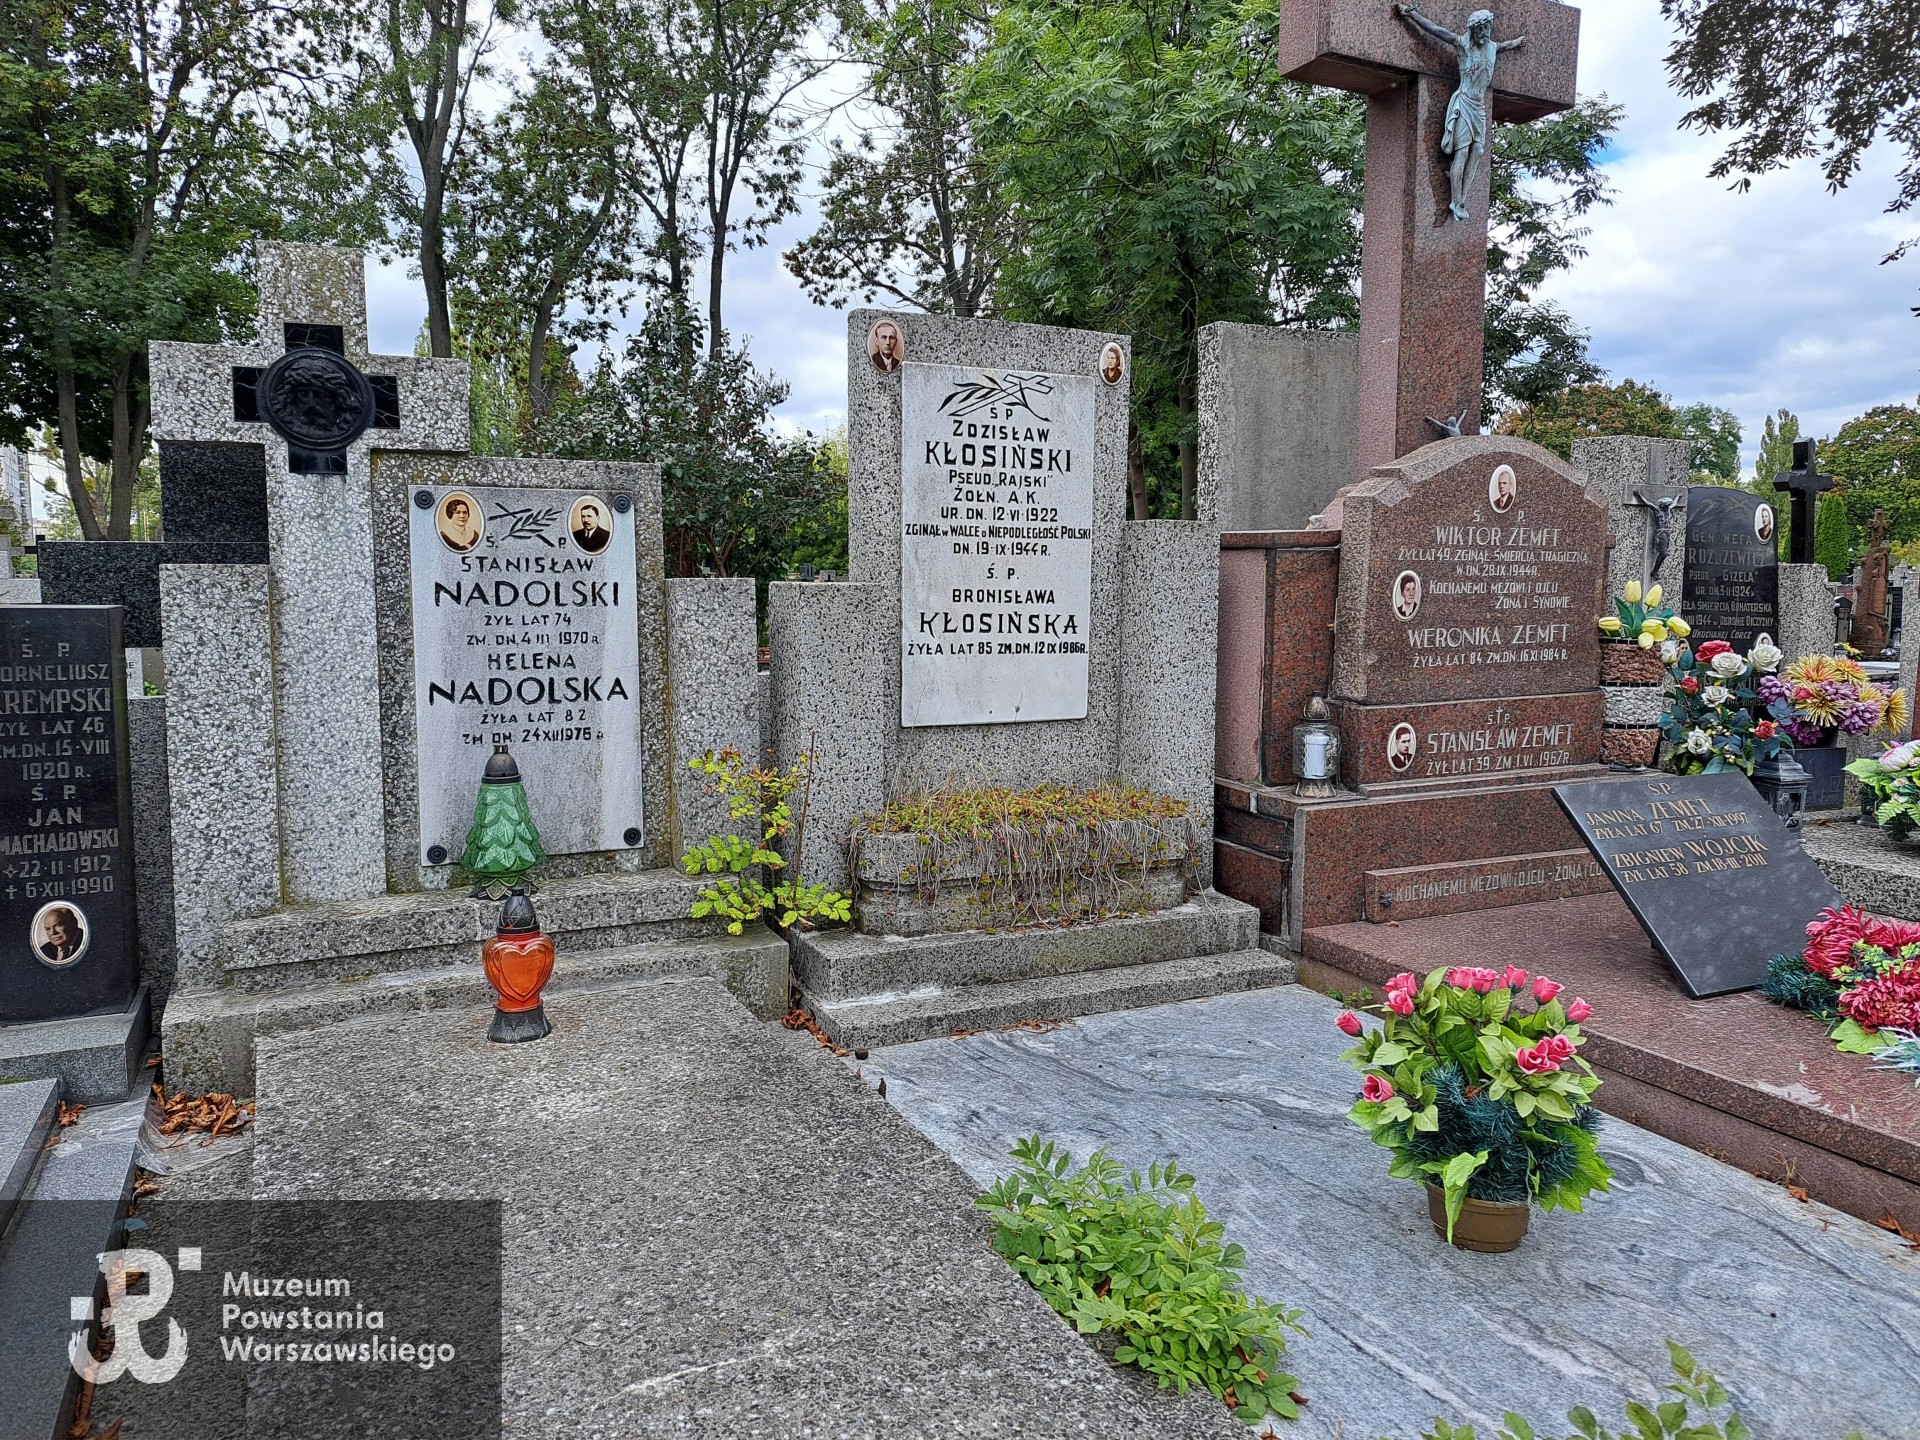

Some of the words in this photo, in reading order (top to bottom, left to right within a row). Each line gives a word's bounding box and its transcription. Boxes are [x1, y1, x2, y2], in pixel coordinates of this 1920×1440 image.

[1006, 407, 1014, 421] P
[952, 419, 1050, 443] ZDZISŁAW
[925, 440, 1073, 476] KŁOSIŃSKI
[953, 485, 1000, 503] ŻOŁN.
[941, 506, 963, 521] UR.
[966, 507, 987, 521] DN.
[905, 523, 942, 538] ZGINĄŁ
[950, 525, 980, 538] WALCE
[988, 524, 1060, 540] NIEPODLEGŁOŚĆ
[1060, 525, 1092, 540] POLSKI
[1436, 526, 1501, 546] WIKTOR
[1507, 528, 1561, 547] ZEMFT
[558, 537, 568, 549] P.
[953, 542, 974, 555] DN.
[460, 556, 595, 574] STANISŁAW
[986, 562, 998, 579] Ś.
[1008, 567, 1020, 580] P.
[1456, 565, 1464, 576] W
[434, 580, 619, 607] NADOLSKI
[952, 588, 1056, 604] BRONISŁAWA
[1429, 580, 1487, 595] KOCHANEMU
[1535, 580, 1559, 594] OJCU
[484, 612, 514, 626] ŻYŁ
[522, 614, 549, 626] LAT
[555, 612, 572, 626] 74
[919, 611, 1078, 640] KŁOSIŃSKA
[559, 631, 589, 645] 1970
[1409, 626, 1502, 649] WERONIKA
[1512, 624, 1571, 645] ZEMFT
[58, 642, 70, 657] P.
[907, 640, 944, 655] ŻYŁA
[950, 642, 975, 655] LAT
[978, 641, 992, 655] 85
[487, 652, 577, 671] HELENA
[1413, 653, 1442, 668] ŻYŁA
[1446, 653, 1466, 666] LAT
[0, 663, 110, 682] ORNELIUSZ
[428, 676, 629, 706] NADOLSKA
[0, 687, 112, 715] REMPSKI
[40, 719, 76, 735] LAT
[82, 717, 105, 734] 46
[479, 710, 518, 725] ŻYŁA
[528, 711, 555, 723] LAT
[1427, 727, 1518, 754] STANISŁAW
[1521, 724, 1575, 748] ZEMFT
[23, 761, 70, 780] 1920
[1425, 760, 1449, 776] ŻYŁ
[1452, 758, 1475, 774] LAT
[63, 784, 77, 800] P.
[28, 806, 82, 827] JAN
[1584, 808, 1645, 826] JANINA
[1645, 798, 1714, 821] ZEMFT
[1625, 823, 1650, 837] LAT
[1650, 820, 1664, 834] 67
[0, 828, 119, 856] MACHAŁOWSKI
[1609, 847, 1686, 868] ZBIGNIEW
[1683, 834, 1770, 858] WÓJCIK
[1646, 866, 1670, 880] LAT
[1670, 862, 1689, 876] 58
[1396, 877, 1466, 902] KOCHANEMU
[1518, 868, 1545, 886] OJCU
[1554, 862, 1582, 882] ŻONA
